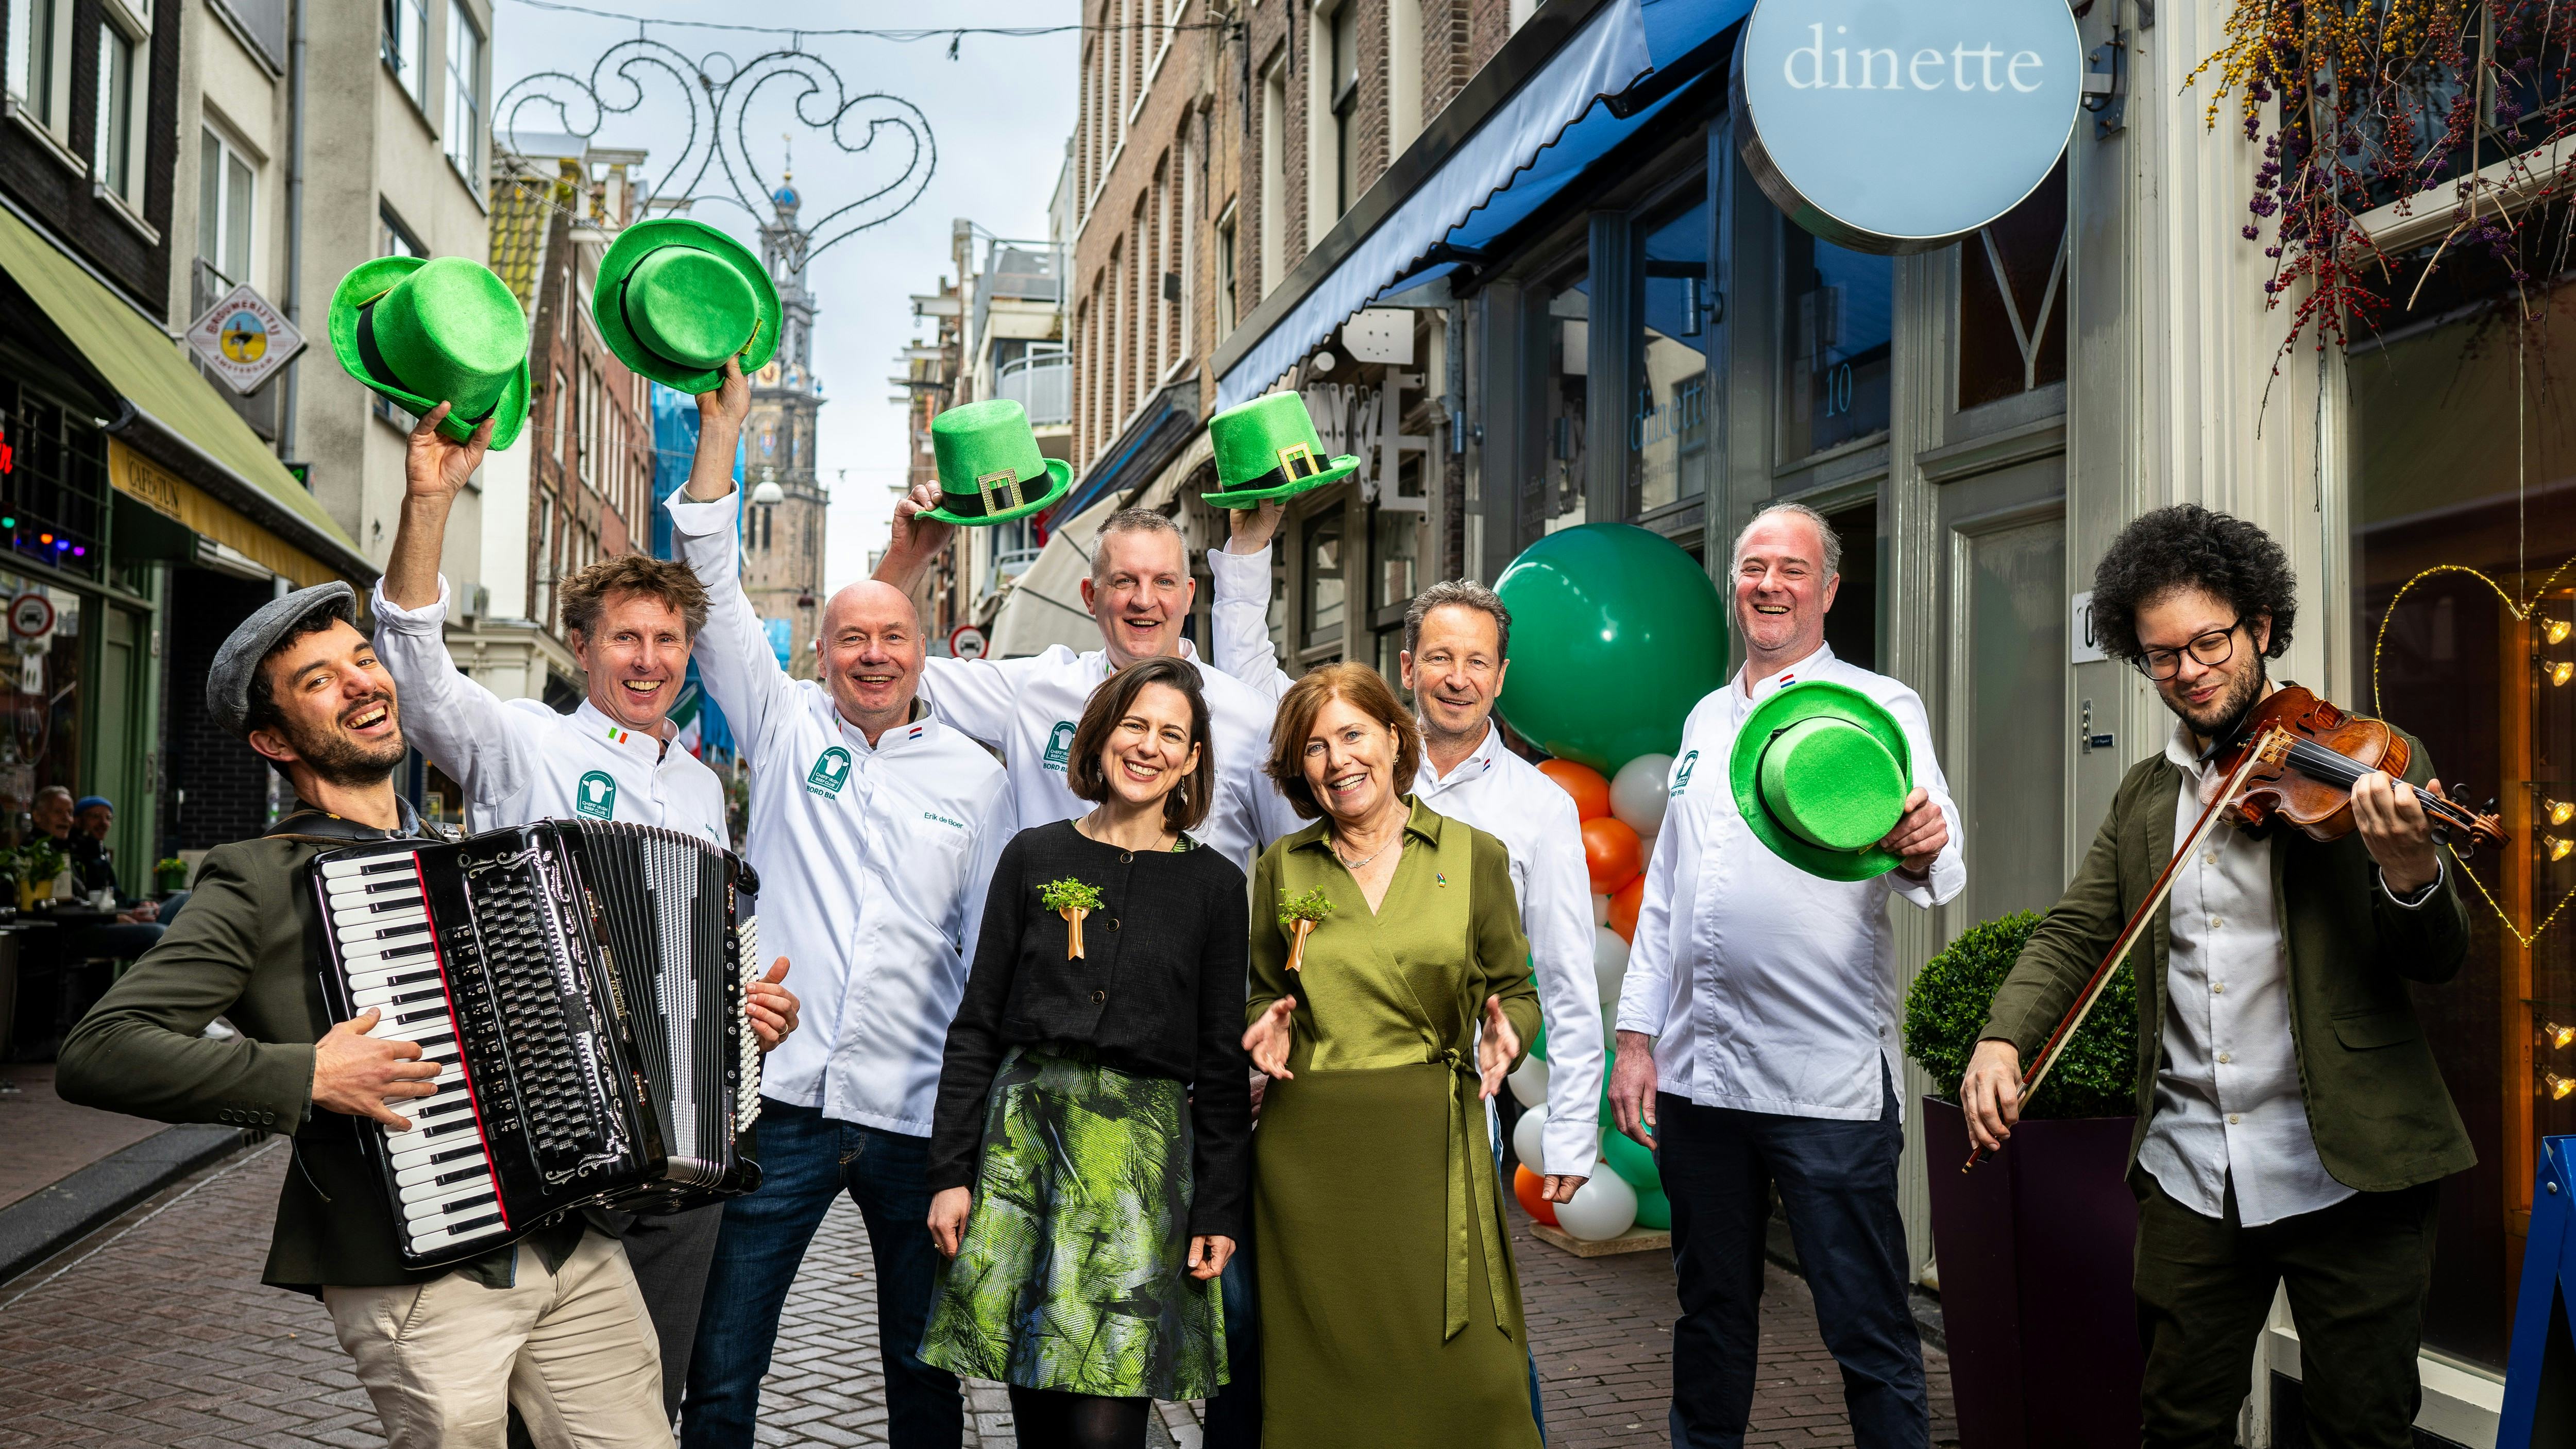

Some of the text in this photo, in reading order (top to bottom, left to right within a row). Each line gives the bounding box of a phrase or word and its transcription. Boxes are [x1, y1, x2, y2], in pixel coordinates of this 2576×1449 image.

[1783, 22, 2044, 93] dinette
[206, 300, 267, 335] BROUWERIJ
[1826, 363, 1852, 418] 10
[806, 786, 835, 800] BORD BIA
[924, 812, 938, 821] Erik
[948, 819, 963, 829] Boer
[611, 980, 625, 1017] BUGARI
